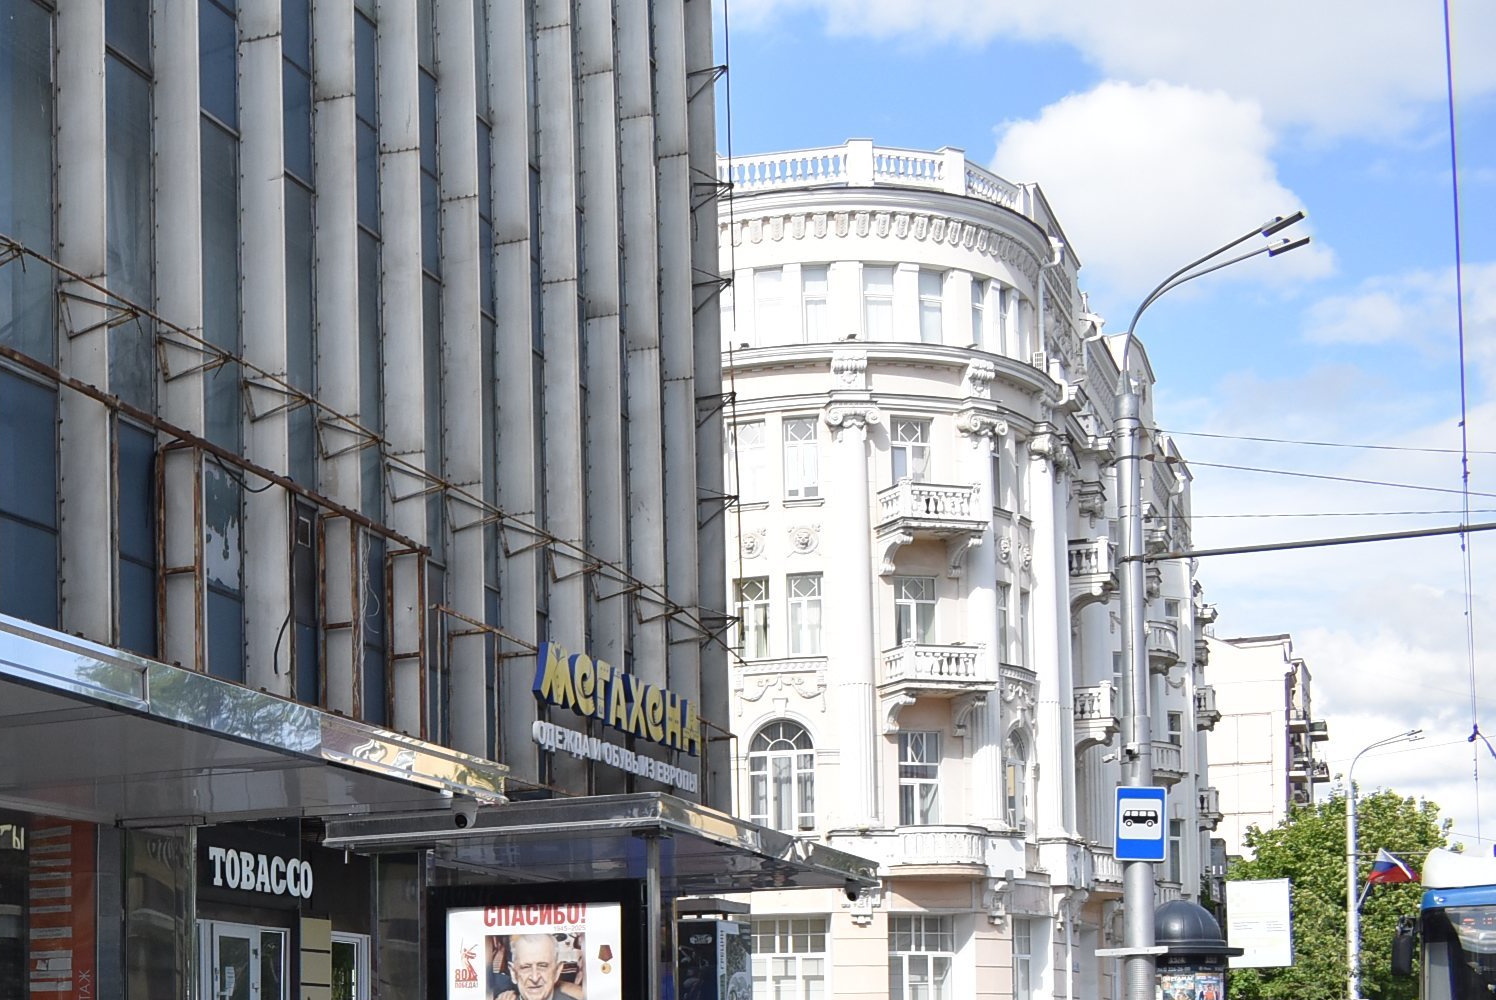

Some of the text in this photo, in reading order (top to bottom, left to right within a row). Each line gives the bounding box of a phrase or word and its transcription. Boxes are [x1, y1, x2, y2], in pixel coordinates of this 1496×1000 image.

[532, 720, 699, 794] ОДЕЖДА И ОБУВЬ ИЗ ЕВРОПЫ
[209, 845, 314, 899] TOBACCO
[483, 903, 588, 928] СПАСИБО!
[454, 969, 469, 982] 80
